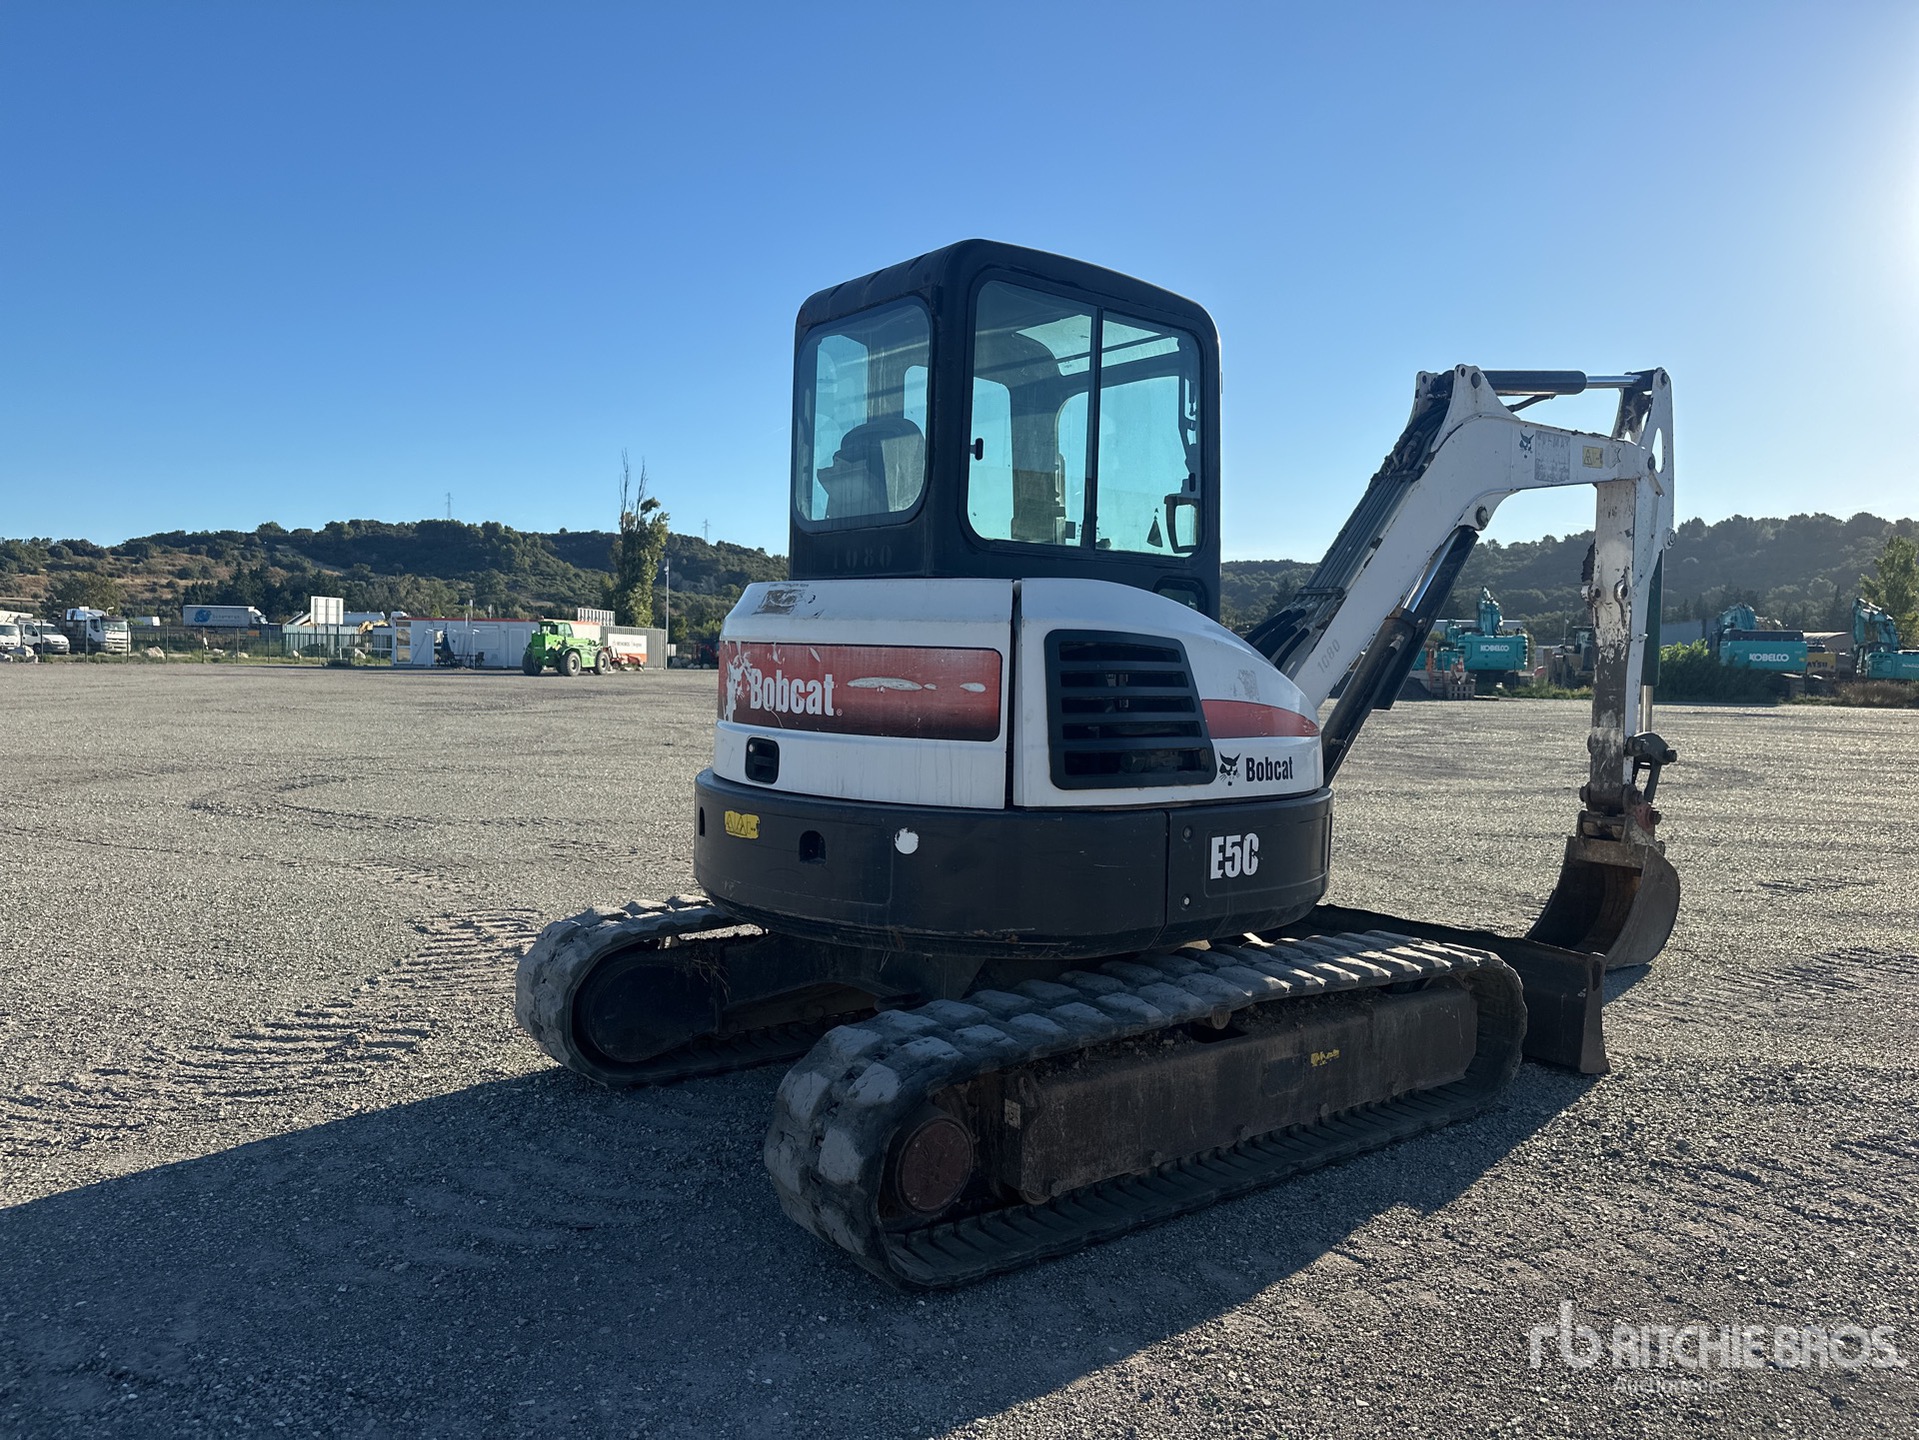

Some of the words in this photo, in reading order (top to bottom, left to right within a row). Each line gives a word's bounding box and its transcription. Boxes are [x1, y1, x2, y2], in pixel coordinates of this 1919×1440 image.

[1317, 638, 1341, 673] 1080
[1480, 644, 1510, 653] KOBELCO
[1748, 653, 1790, 663] KOBELCO
[750, 668, 835, 717] Bobcat
[1245, 756, 1294, 782] Bobcat
